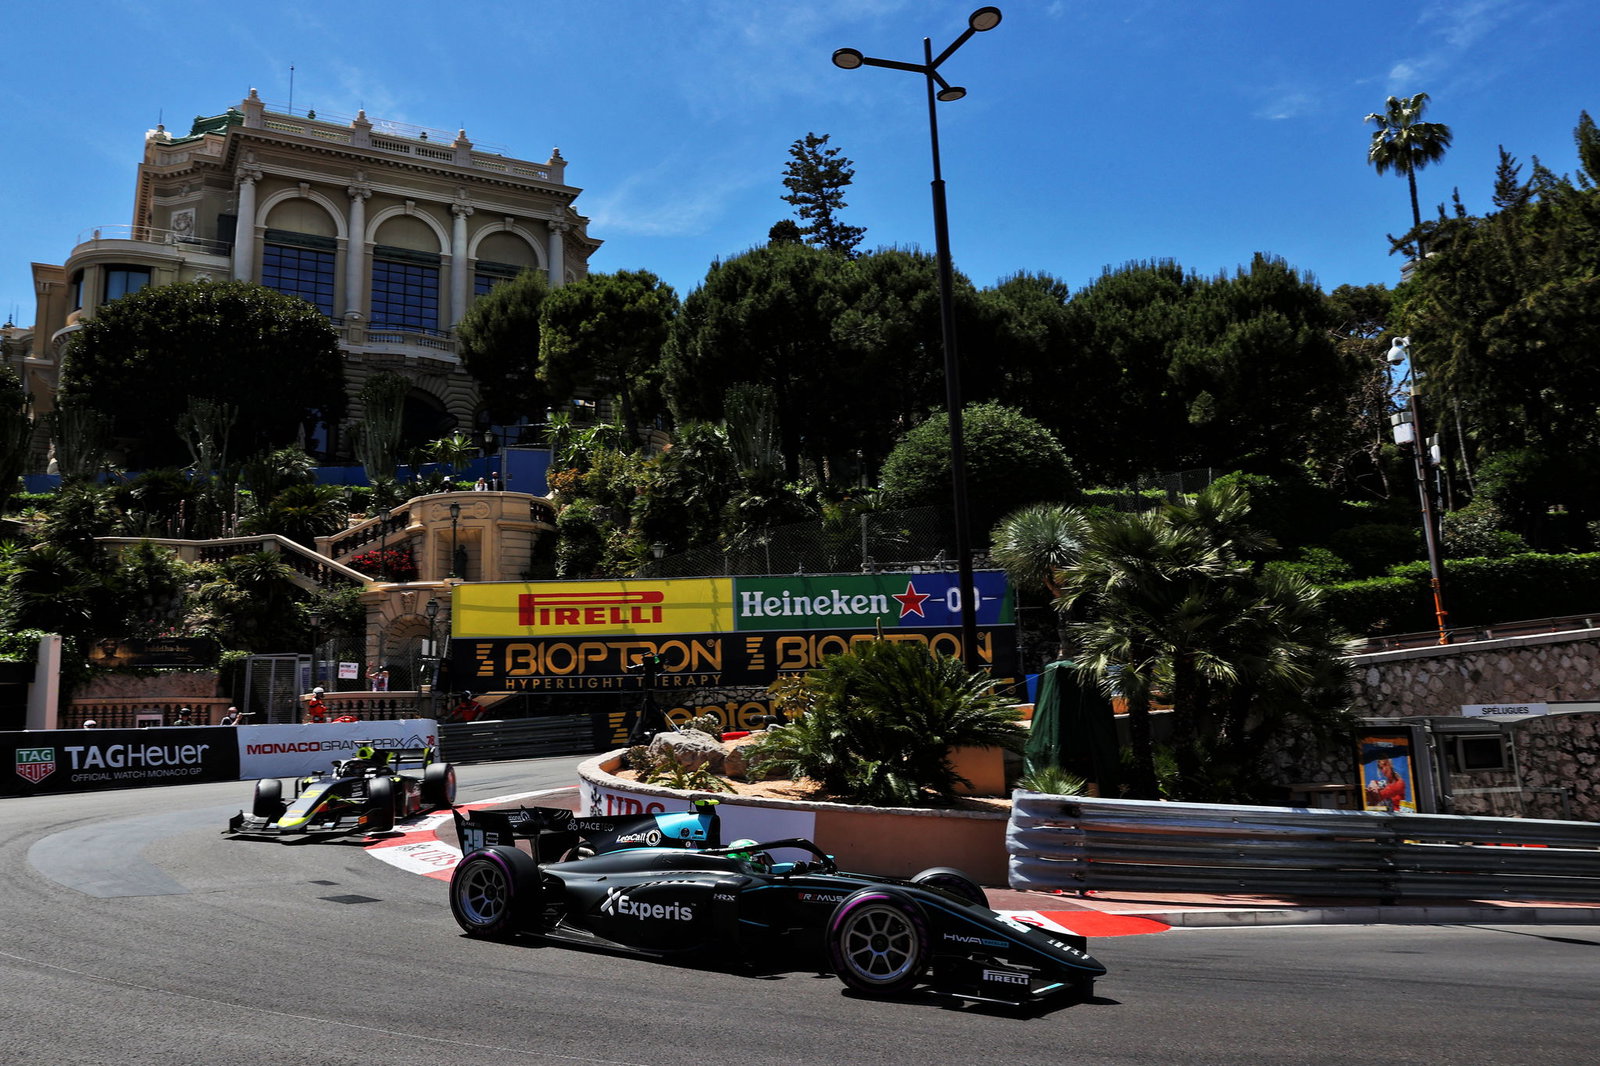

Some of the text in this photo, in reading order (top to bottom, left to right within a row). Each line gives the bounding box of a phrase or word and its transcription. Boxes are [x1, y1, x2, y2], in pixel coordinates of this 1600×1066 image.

[518, 591, 664, 626] PIRELLI
[740, 590, 889, 617] Heineken
[505, 677, 624, 690] HYPERLIGHT
[1481, 706, 1529, 715] SPÉLUGUES
[19, 750, 51, 762] TAG
[19, 763, 54, 784] HEUER
[71, 767, 203, 783] OFFICIAL WATCH MONACO GP
[943, 933, 982, 945] HWA
[983, 969, 1030, 985] PIRELLI
